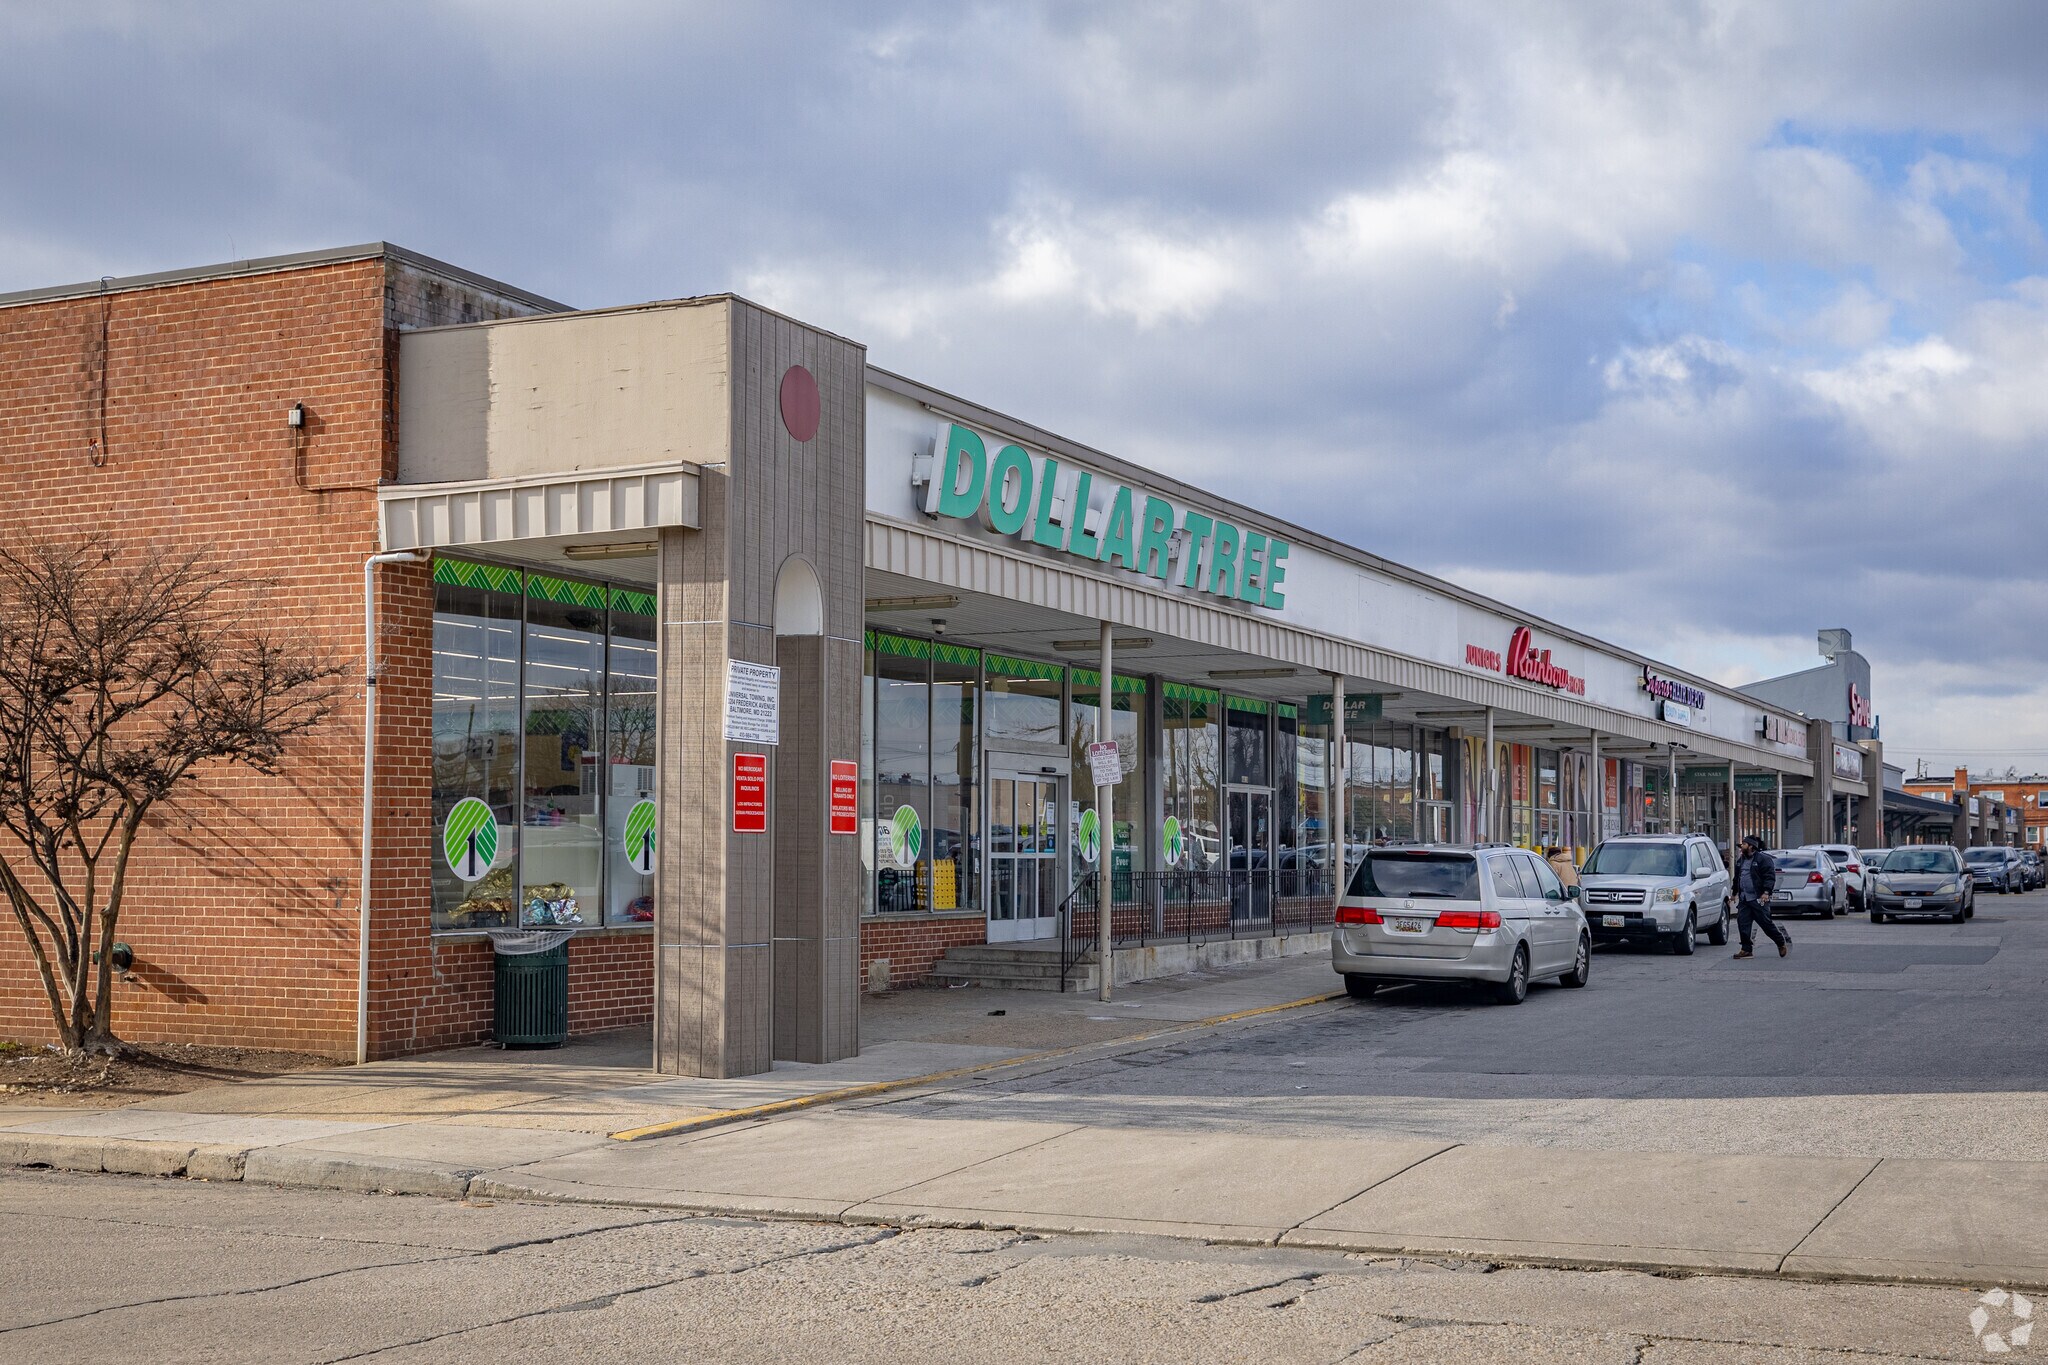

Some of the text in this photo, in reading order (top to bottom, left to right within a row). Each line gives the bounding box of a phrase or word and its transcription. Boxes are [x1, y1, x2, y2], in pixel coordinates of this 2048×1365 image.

[936, 422, 1289, 609] DOLLAR TREE
[1466, 644, 1501, 672] JUNIORS
[1506, 626, 1568, 688] Rainbow
[731, 665, 749, 675] PRIVATE
[749, 669, 776, 679] PROPERTY
[1323, 701, 1366, 710] DLAR
[1673, 681, 1687, 704] HAIR
[1687, 687, 1705, 709] DEPOT
[1092, 749, 1116, 757] LOITERING
